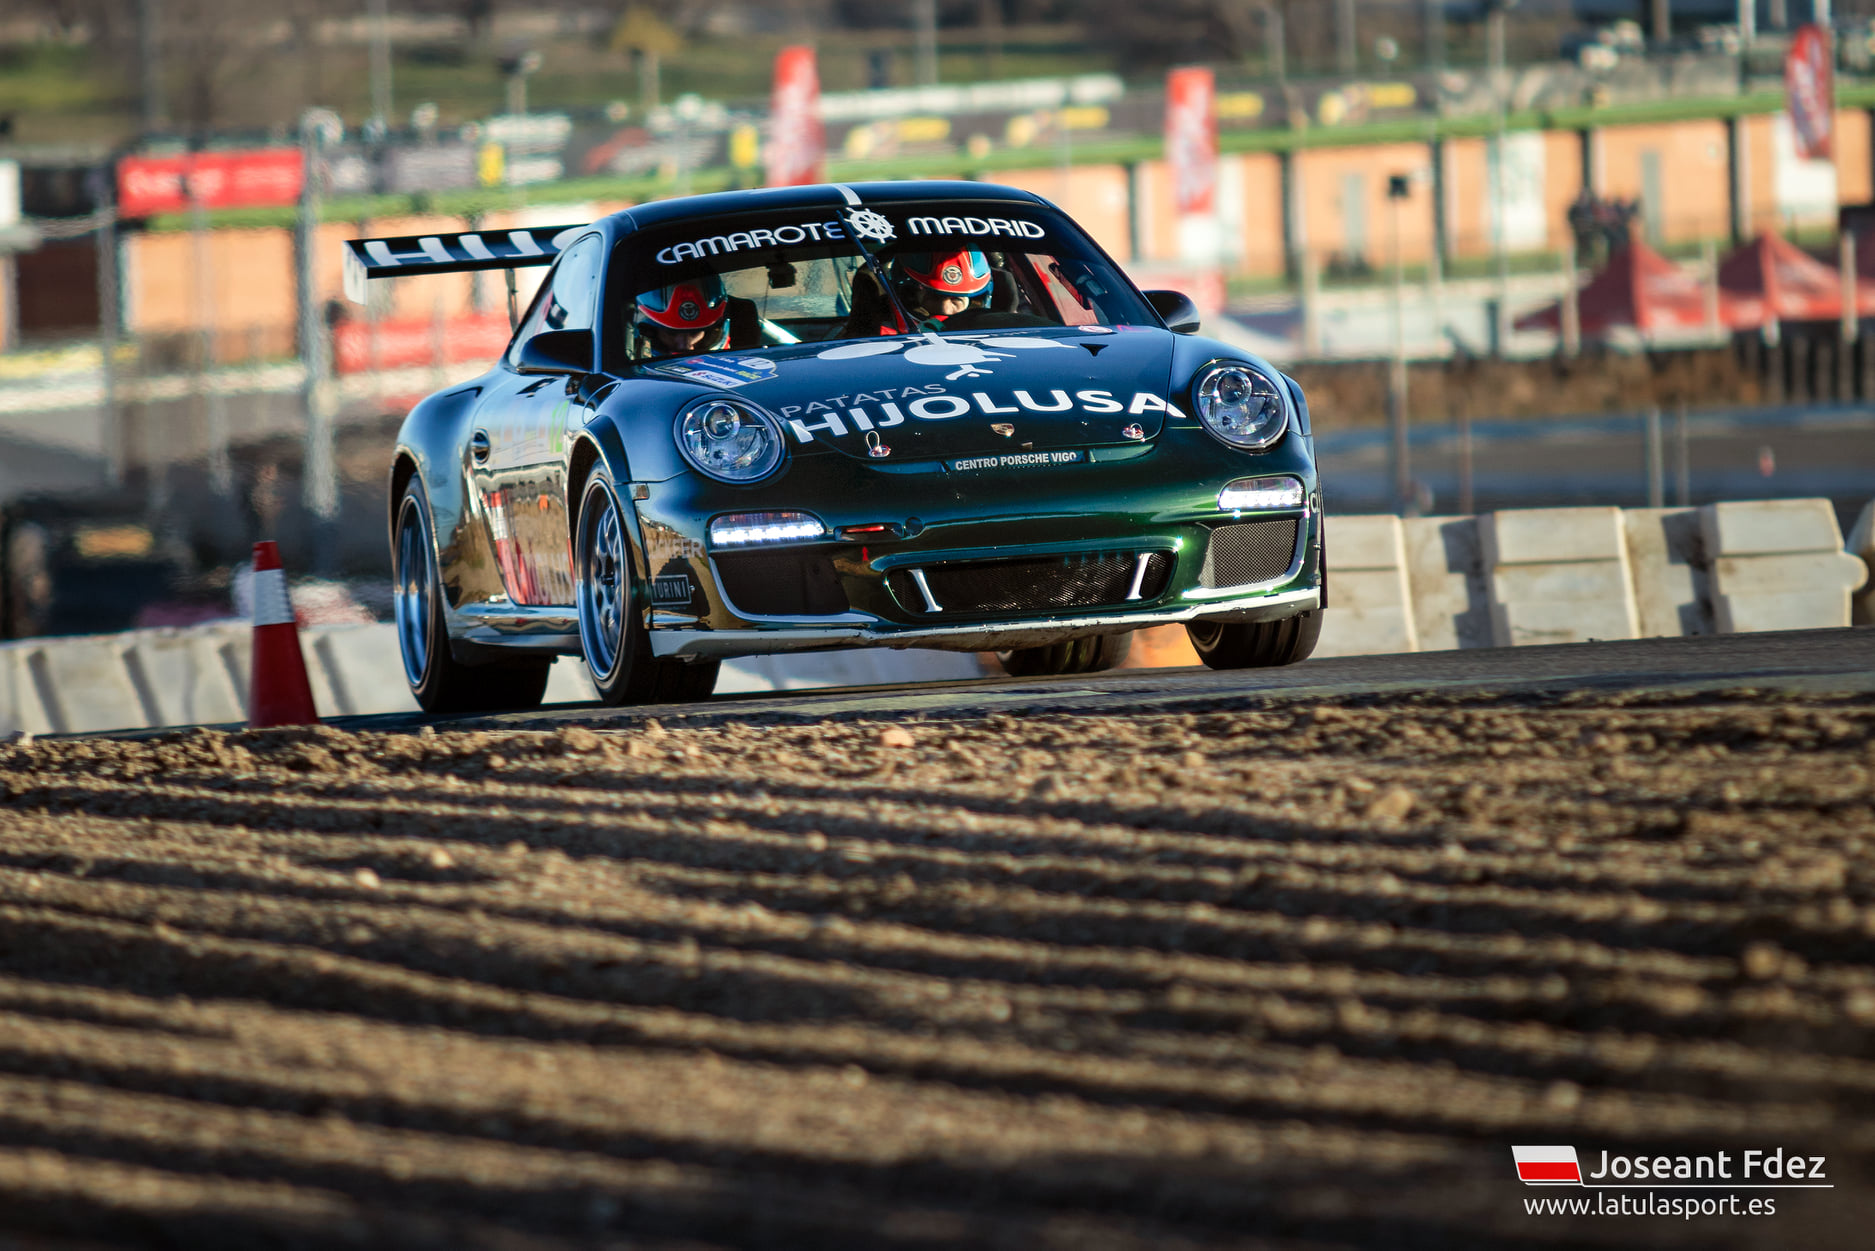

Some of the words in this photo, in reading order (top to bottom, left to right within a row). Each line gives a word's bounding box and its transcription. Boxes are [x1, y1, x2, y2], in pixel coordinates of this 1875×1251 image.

[656, 221, 846, 264] CAMAROTE
[907, 217, 1046, 240] MADRID
[780, 383, 947, 418] PATATAS
[788, 389, 1187, 444] HIJOLUSA
[955, 455, 998, 471] CENTRO
[1000, 452, 1050, 467] PORSCHE
[1051, 452, 1078, 463] VIGO
[652, 580, 688, 599] TURINI
